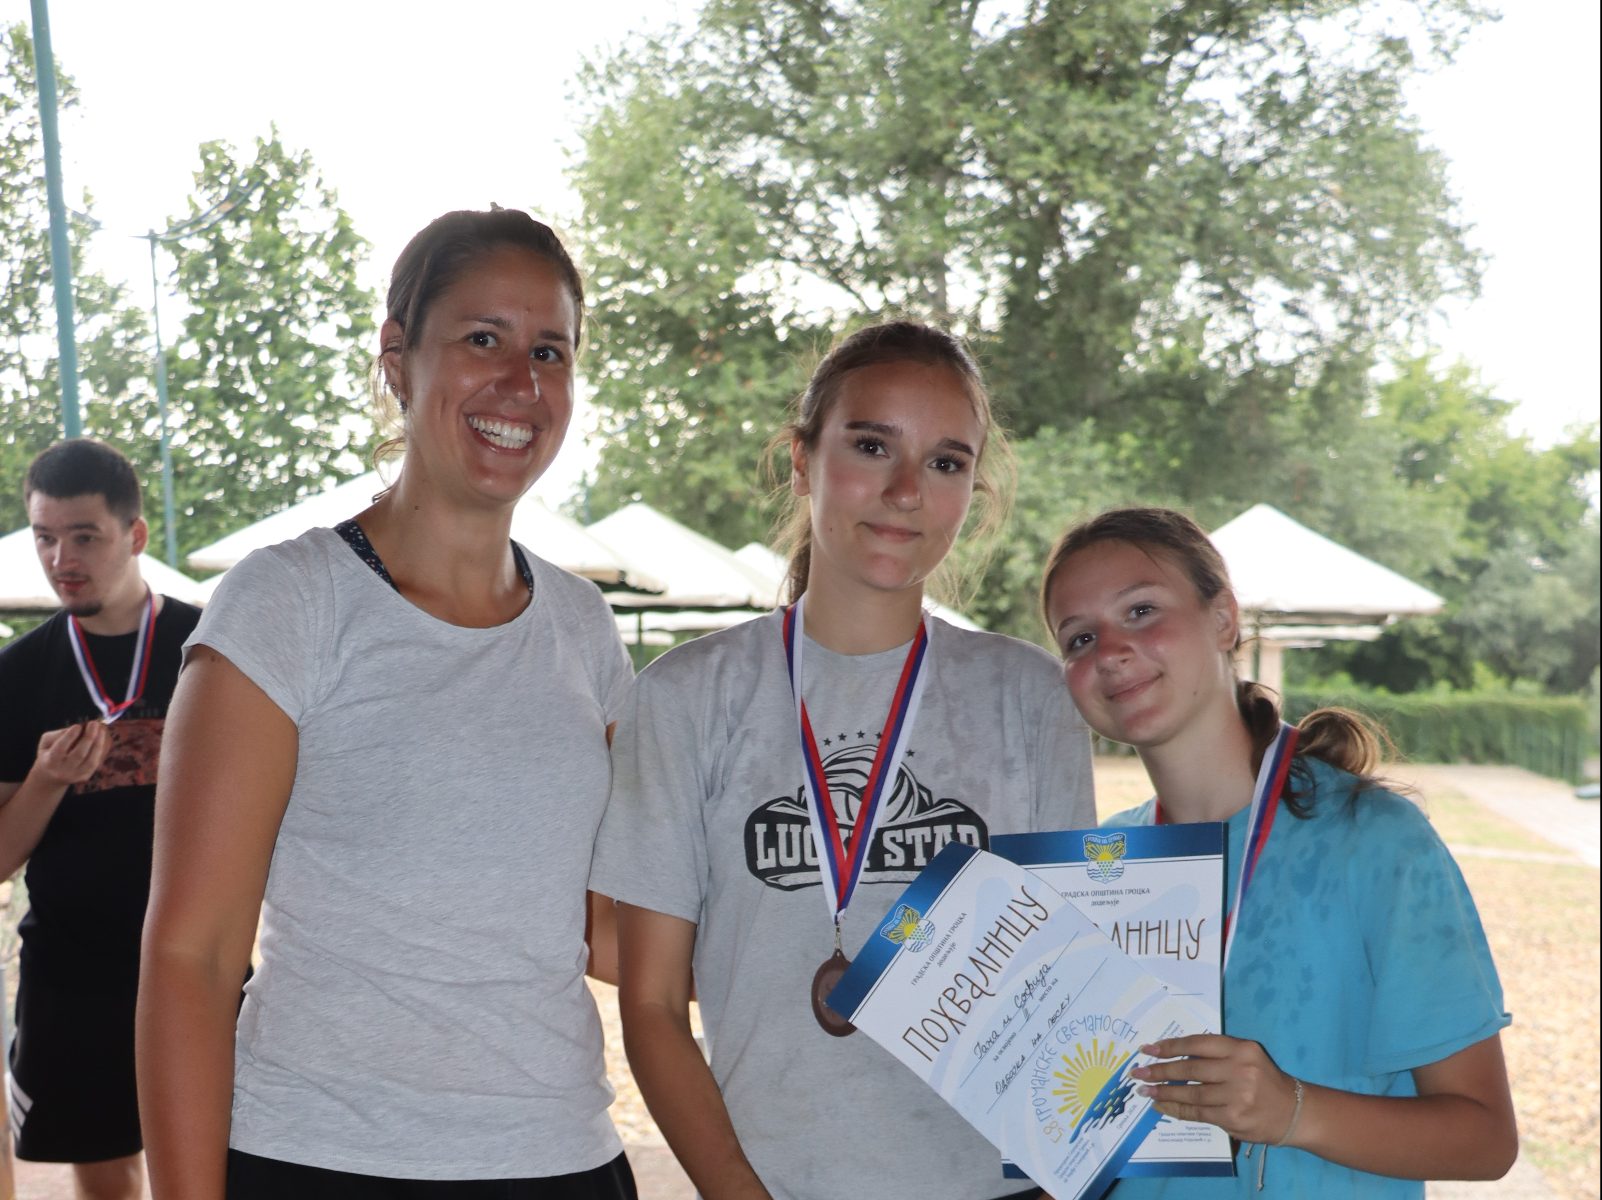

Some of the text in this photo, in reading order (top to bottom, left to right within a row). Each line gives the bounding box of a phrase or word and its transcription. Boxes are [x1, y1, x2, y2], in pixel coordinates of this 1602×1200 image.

[1090, 889, 1123, 897] ОПШТИНА
[1125, 888, 1150, 896] ГРОЦКА
[911, 912, 967, 986] ГРАДСКА ОПШТИНА ГРОЦКА
